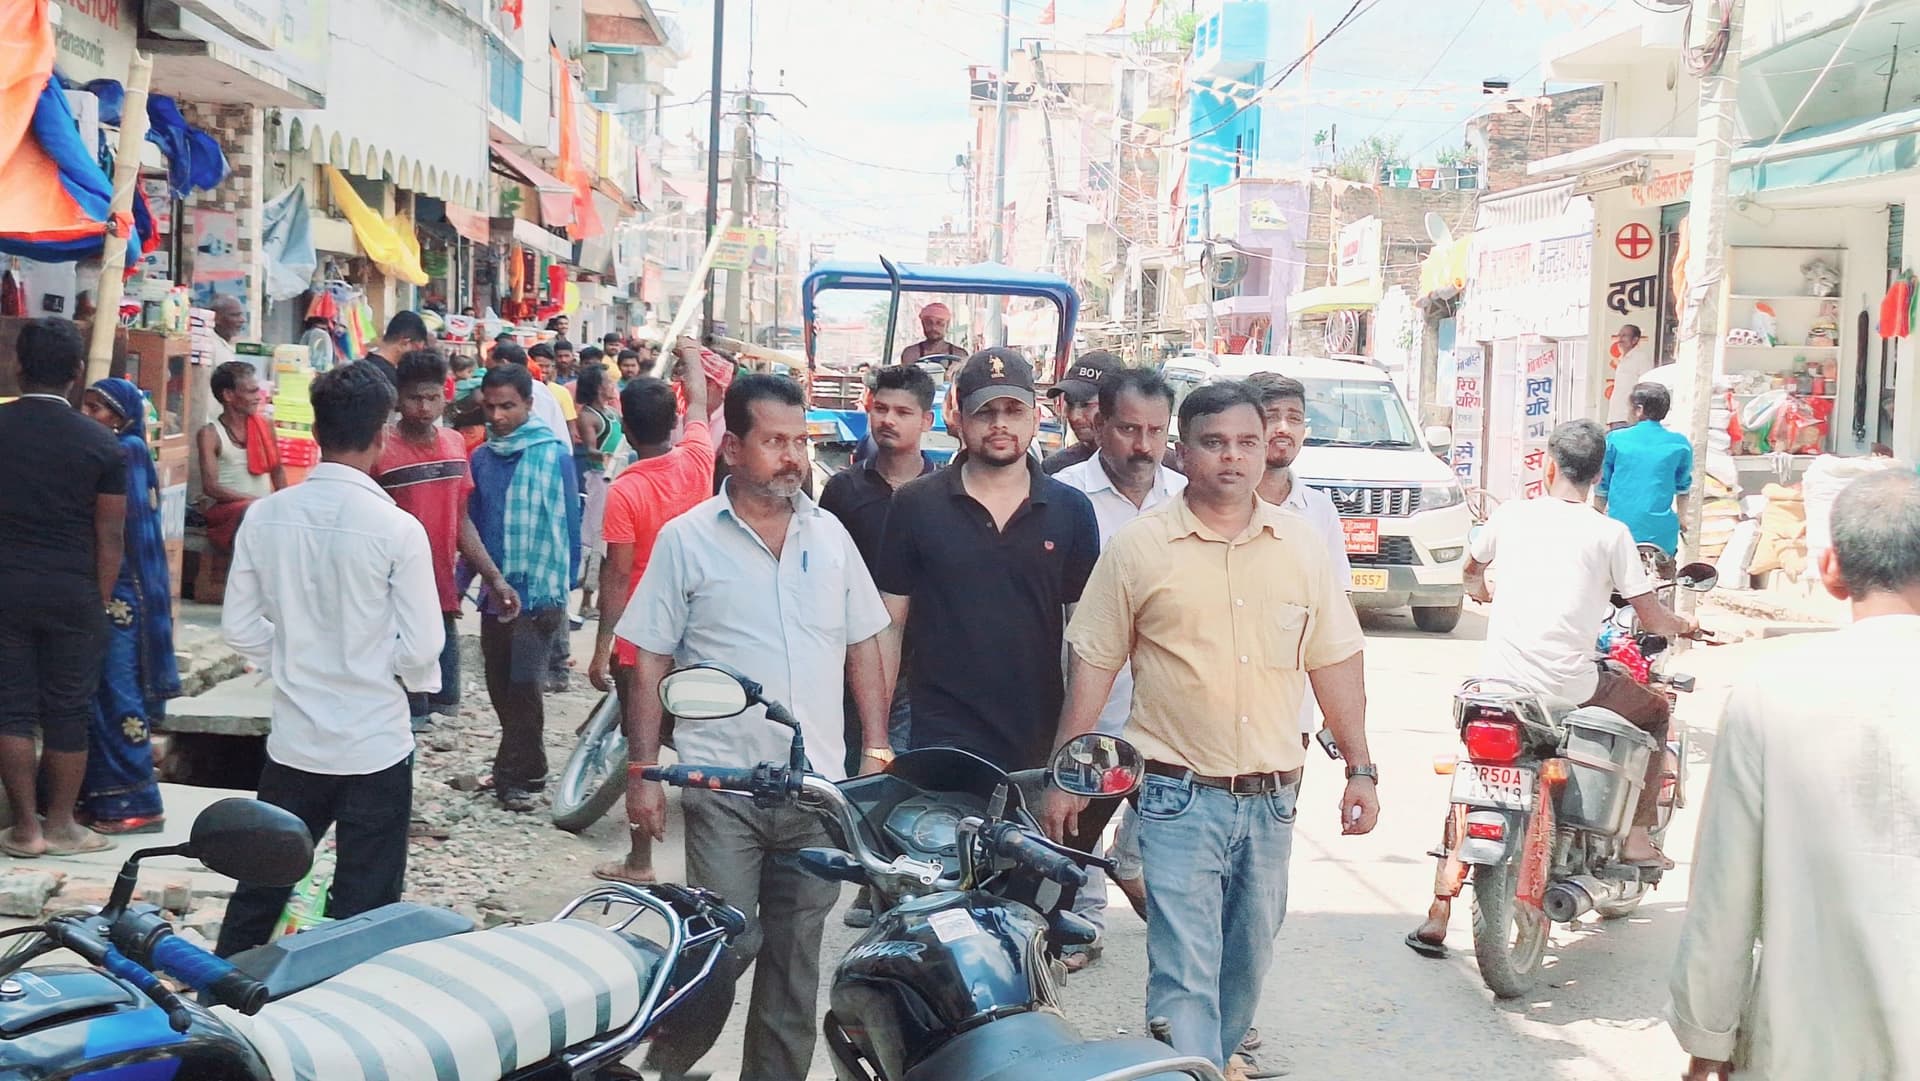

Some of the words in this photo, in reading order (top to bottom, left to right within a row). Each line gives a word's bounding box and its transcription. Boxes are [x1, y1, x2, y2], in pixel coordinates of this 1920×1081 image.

[1606, 274, 1657, 315] दवा
[1079, 366, 1103, 380] BOY
[1352, 574, 1382, 585] 8557
